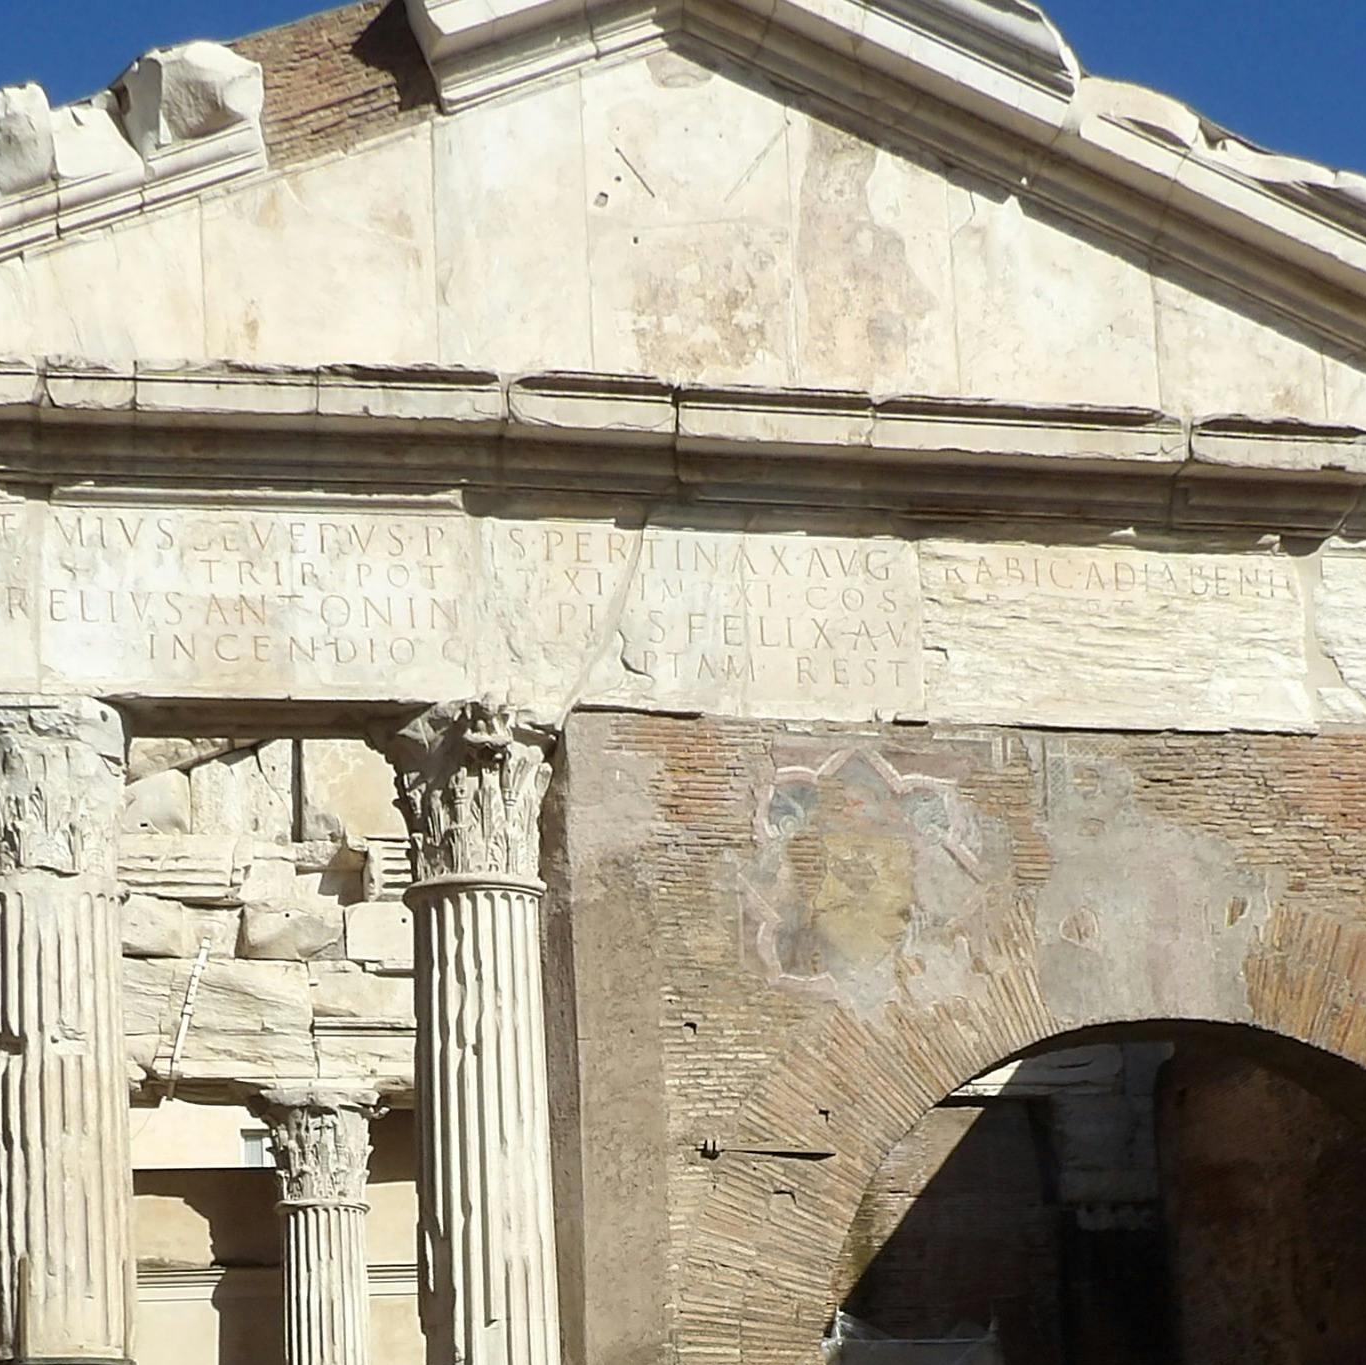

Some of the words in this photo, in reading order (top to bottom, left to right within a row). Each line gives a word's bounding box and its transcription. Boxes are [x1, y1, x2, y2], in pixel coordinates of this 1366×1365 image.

[806, 547, 891, 582] AVG
[804, 586, 898, 616] COS
[687, 613, 834, 654] FELIX
[148, 632, 416, 665] INCENDIO
[797, 656, 909, 688] REST
